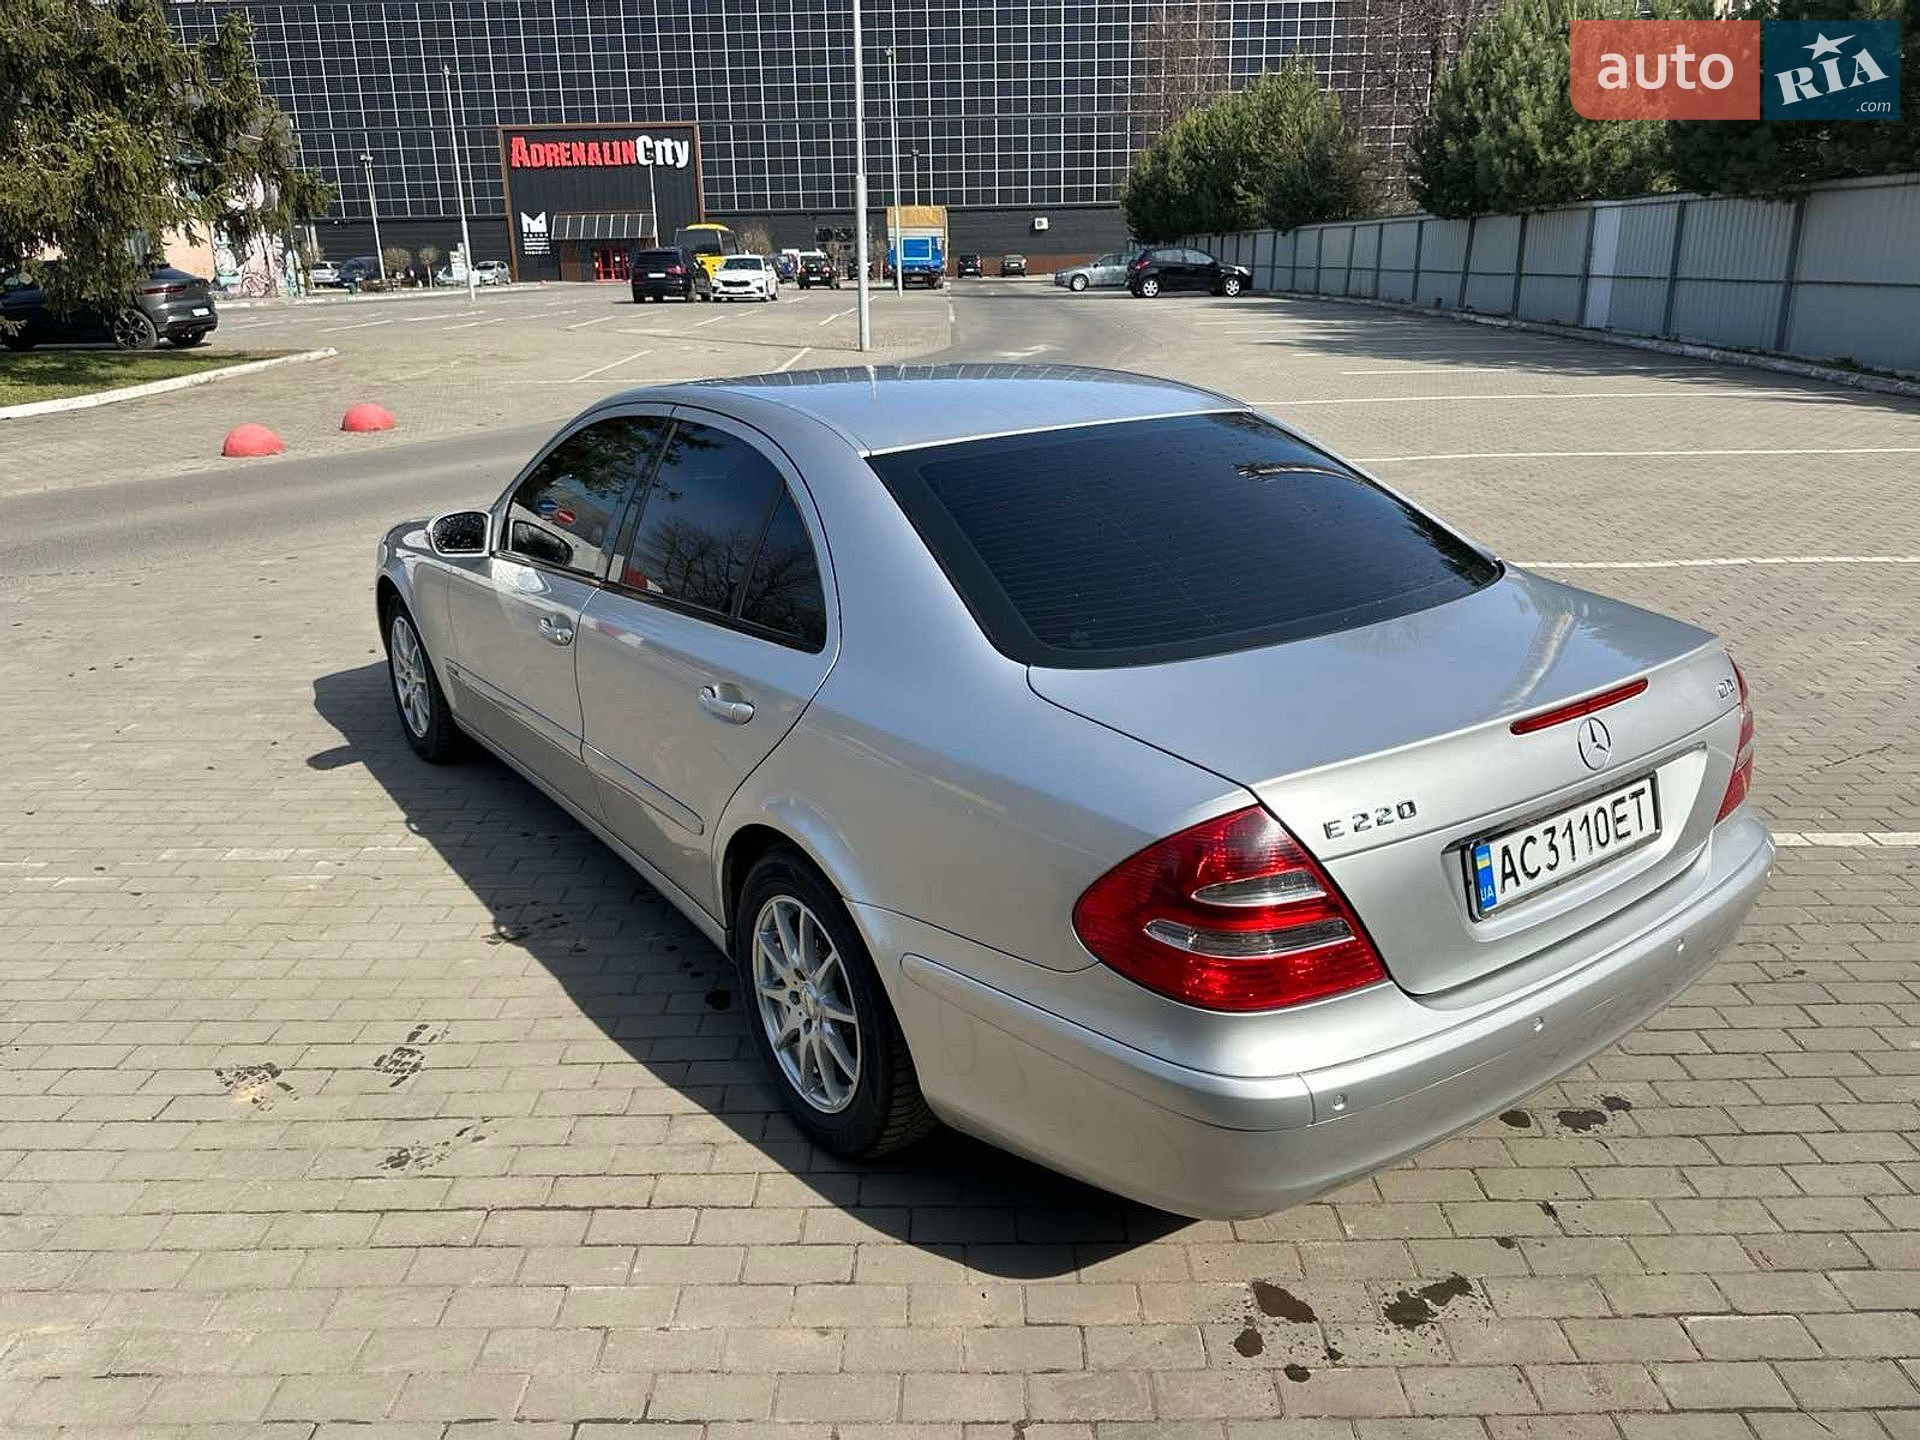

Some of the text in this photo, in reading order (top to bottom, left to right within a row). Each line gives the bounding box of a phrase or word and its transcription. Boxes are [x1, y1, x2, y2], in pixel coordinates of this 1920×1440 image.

[1323, 800, 1417, 840] E 220
[1500, 788, 1646, 894] AC3110ET
[1480, 887, 1495, 901] UA
